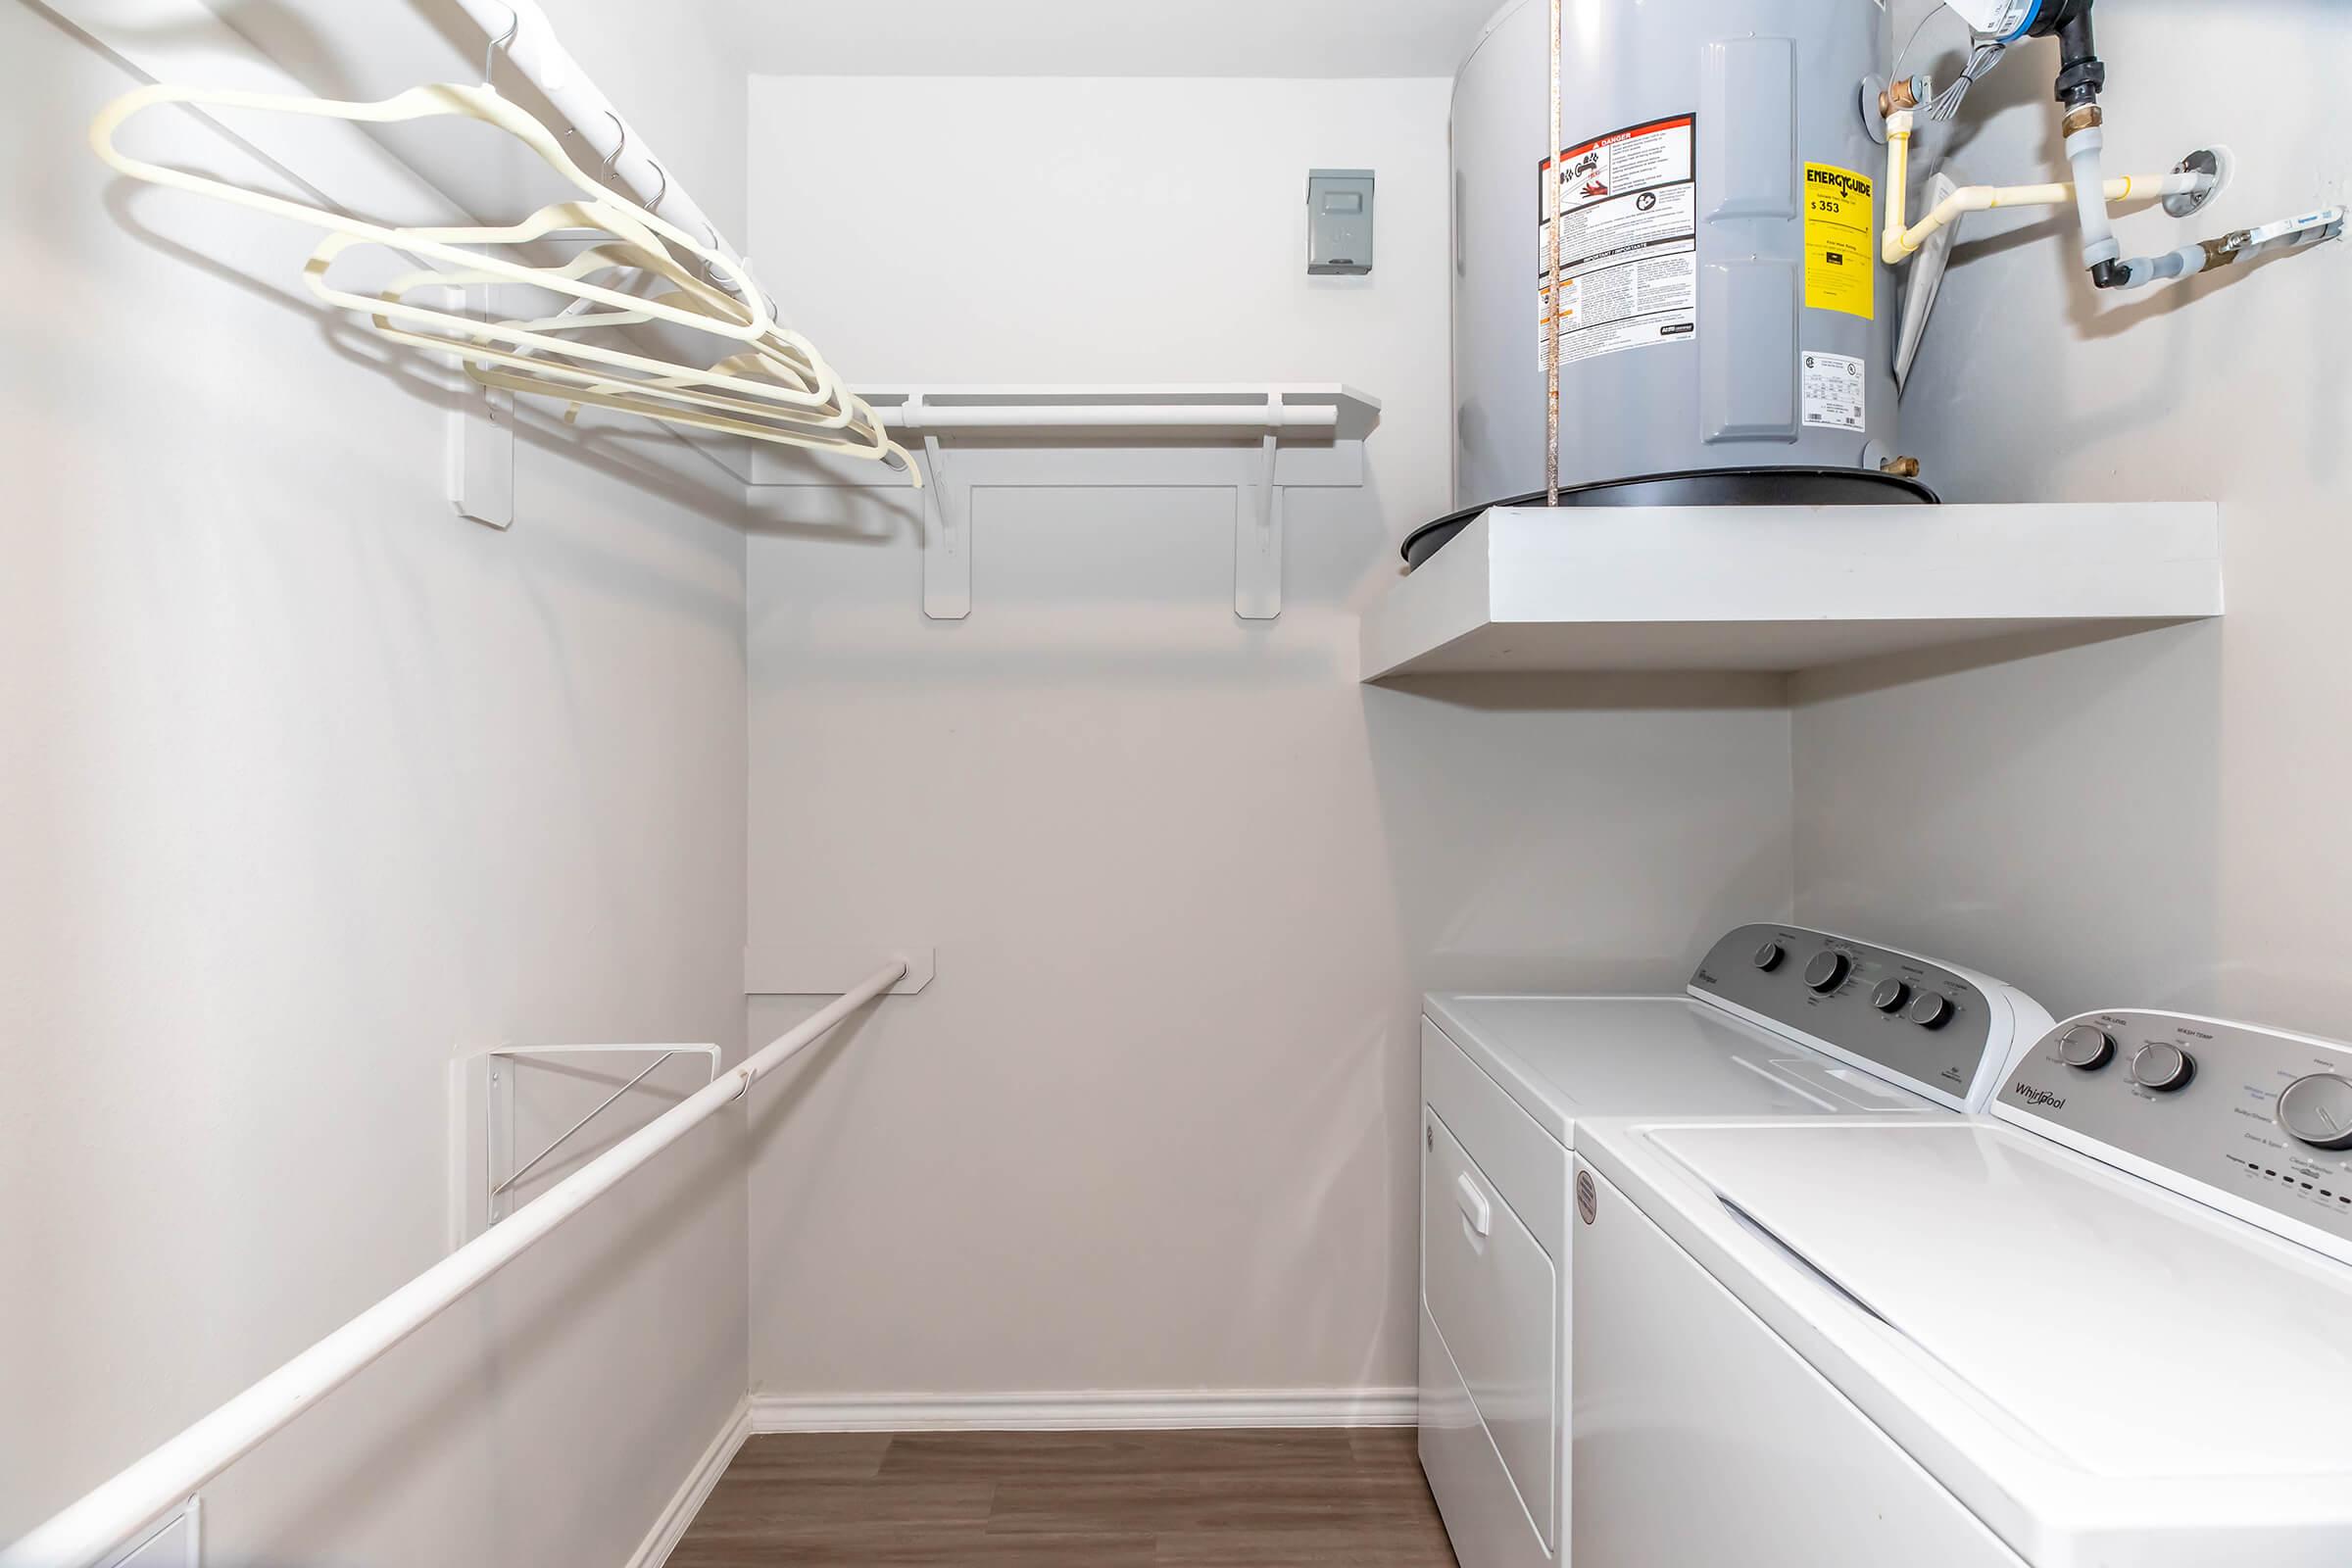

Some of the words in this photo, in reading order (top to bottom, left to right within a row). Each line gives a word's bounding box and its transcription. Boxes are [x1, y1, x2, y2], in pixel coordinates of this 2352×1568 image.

[1601, 132, 1632, 146] DANGER
[1806, 169, 1871, 198] ENERGYGUIDE
[1811, 201, 1817, 210] $
[1819, 200, 1839, 213] 353
[1584, 250, 1610, 263] IMPORTANT
[2177, 1027, 2195, 1037] WASH
[2195, 1031, 2213, 1041] TEMP
[2015, 1082, 2066, 1110] Whirlpool
